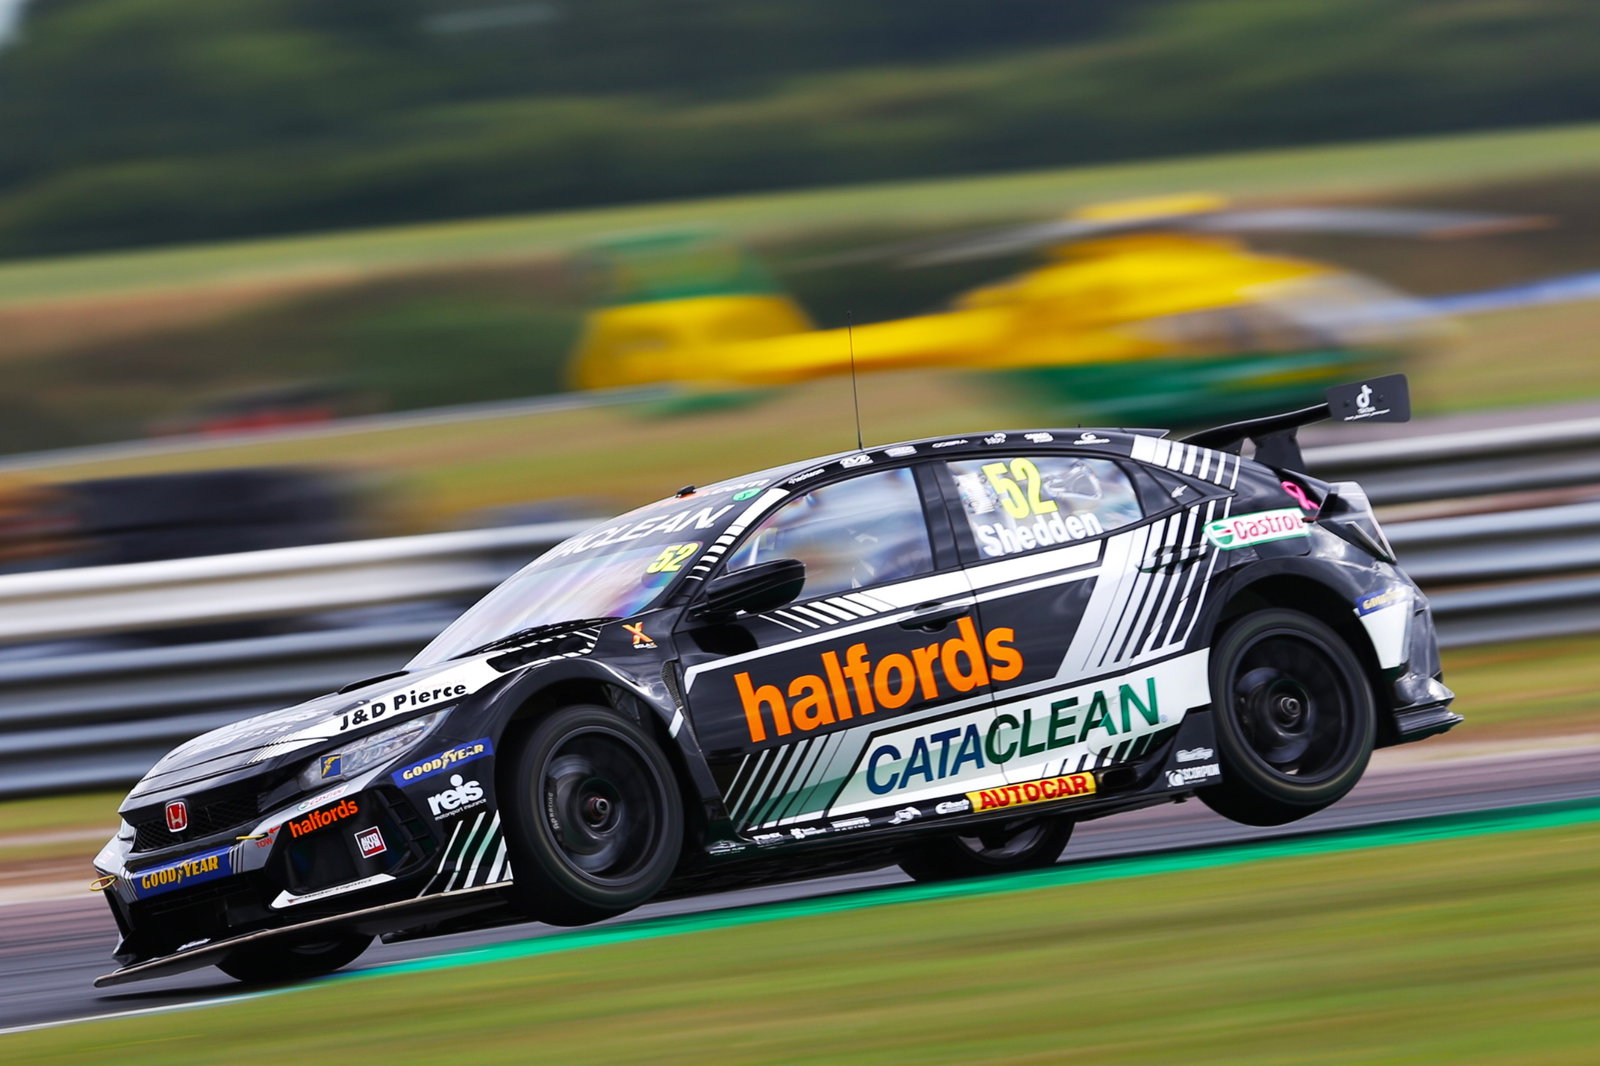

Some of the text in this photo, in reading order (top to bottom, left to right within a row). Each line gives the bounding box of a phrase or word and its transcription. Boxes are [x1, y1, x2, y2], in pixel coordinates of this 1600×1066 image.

[981, 458, 1060, 519] 52
[977, 511, 1104, 557] Shedden
[1233, 511, 1304, 540] Castrol
[646, 543, 700, 574] 52
[734, 616, 1024, 743] halfords
[339, 702, 387, 731] J&D
[393, 684, 467, 711] Pierce
[866, 677, 1160, 795] CATACLEAN
[427, 773, 484, 816] reis
[980, 775, 1090, 810] AUTOCAR
[288, 800, 359, 838] halfords
[255, 837, 273, 848] TOW
